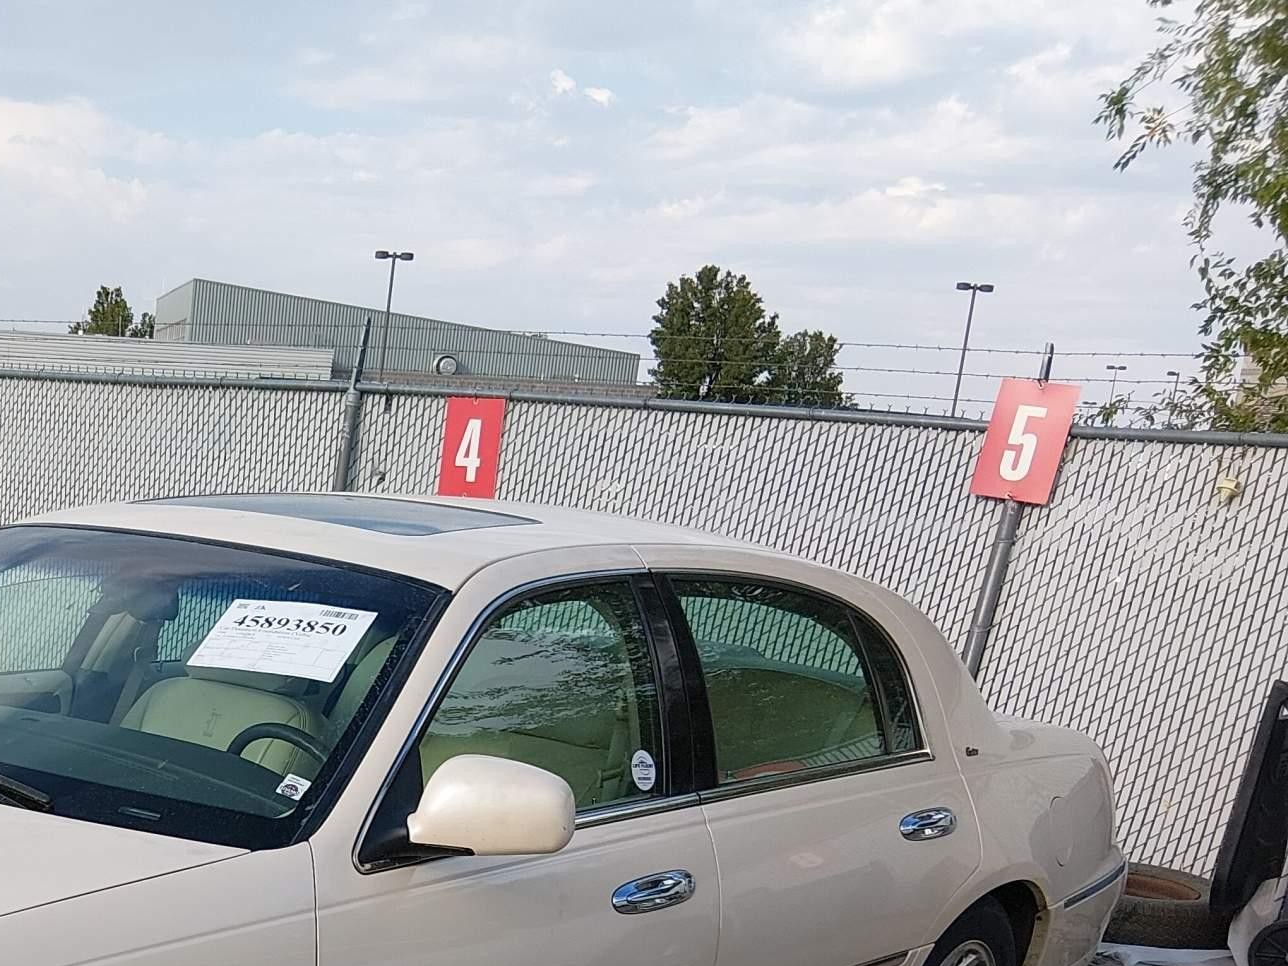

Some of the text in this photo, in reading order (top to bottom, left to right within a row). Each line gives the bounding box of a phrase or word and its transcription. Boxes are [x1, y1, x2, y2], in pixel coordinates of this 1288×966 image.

[454, 418, 482, 483] 4
[999, 404, 1048, 482] 5
[233, 614, 348, 637] 45893850
